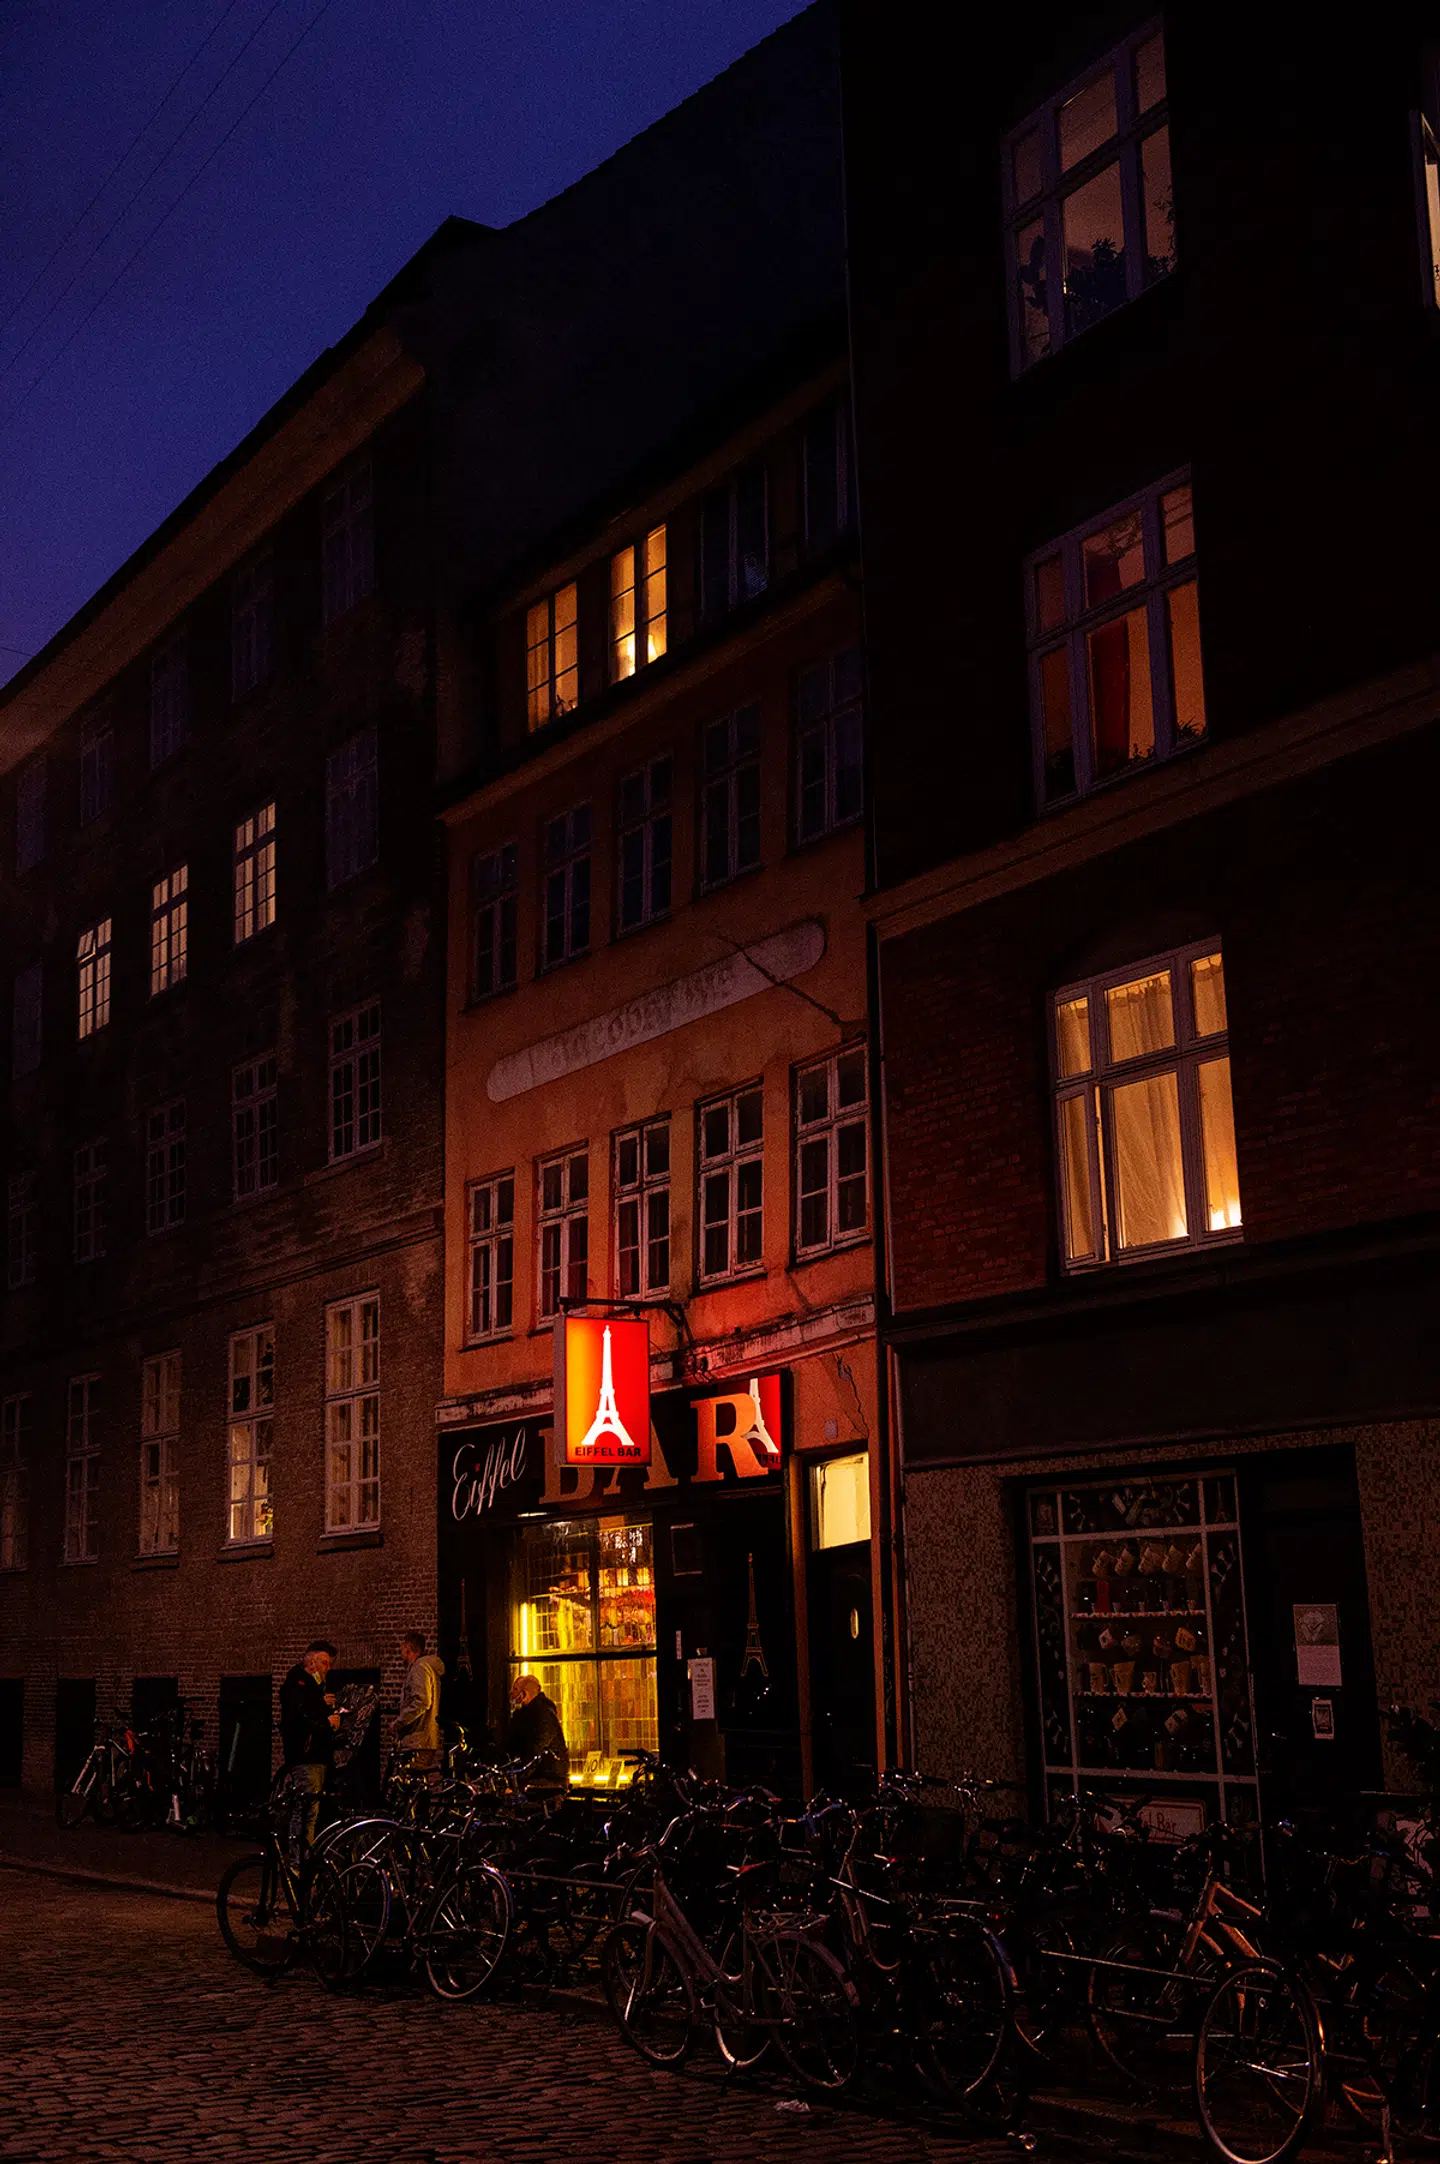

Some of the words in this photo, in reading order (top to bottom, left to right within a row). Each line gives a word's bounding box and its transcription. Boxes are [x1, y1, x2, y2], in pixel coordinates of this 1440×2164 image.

[452, 1426, 528, 1521] Eiffel
[575, 1447, 615, 1456] EIFFEL
[617, 1447, 642, 1457] BAR
